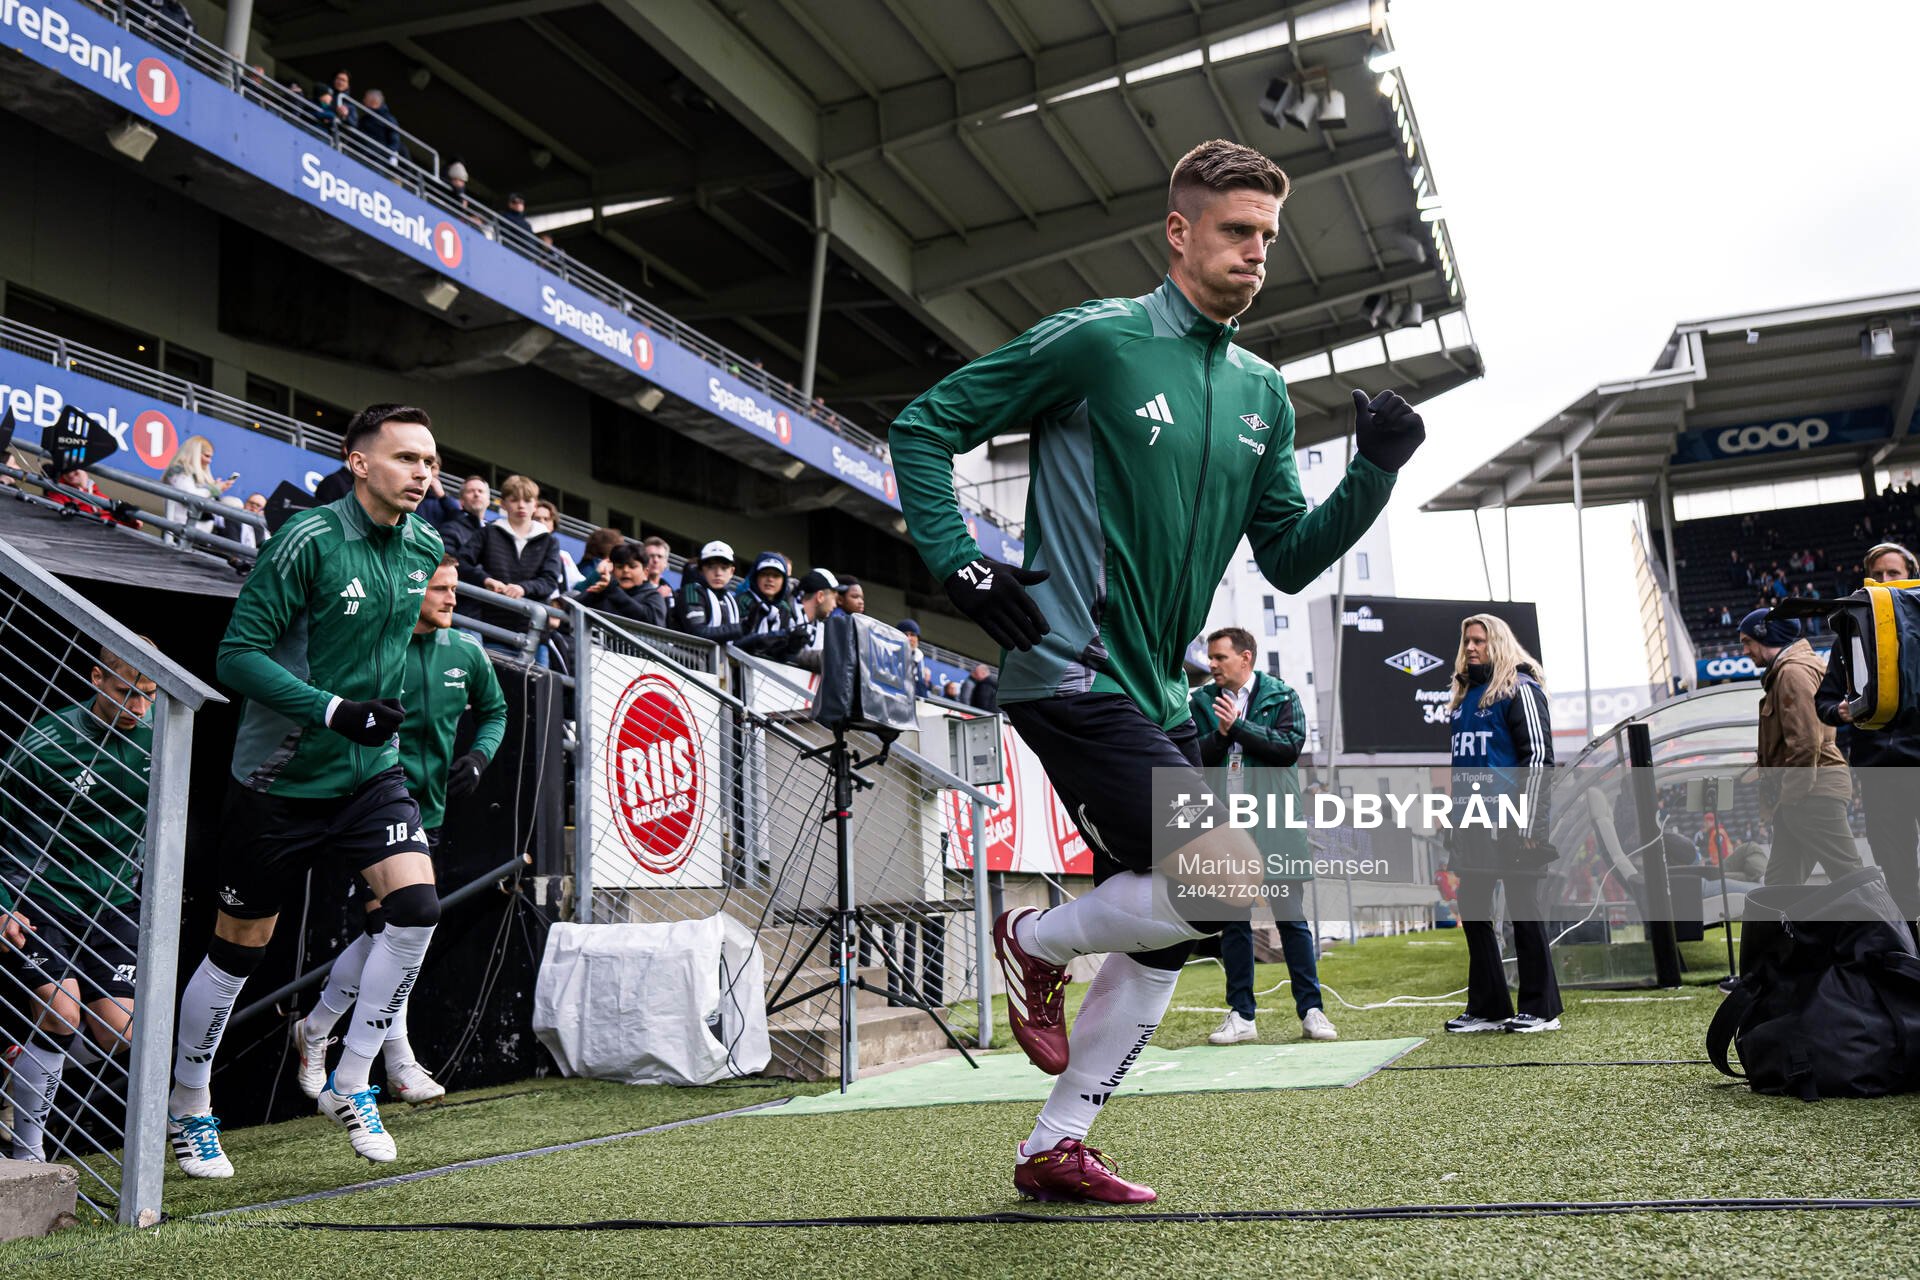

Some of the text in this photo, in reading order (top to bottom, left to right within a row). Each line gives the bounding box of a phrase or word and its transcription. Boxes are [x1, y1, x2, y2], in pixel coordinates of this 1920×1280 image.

[0, 0, 166, 104] reBank 1
[302, 152, 455, 260] SpareBank 1
[541, 285, 648, 363] SpareBank 1
[708, 376, 788, 438] SpareBank 1
[57, 436, 88, 446] SONY
[146, 420, 164, 458] 1
[1148, 425, 1161, 446] 7
[1717, 418, 1829, 453] coop
[621, 736, 693, 807] RIIS
[631, 793, 690, 826] BILGLASS
